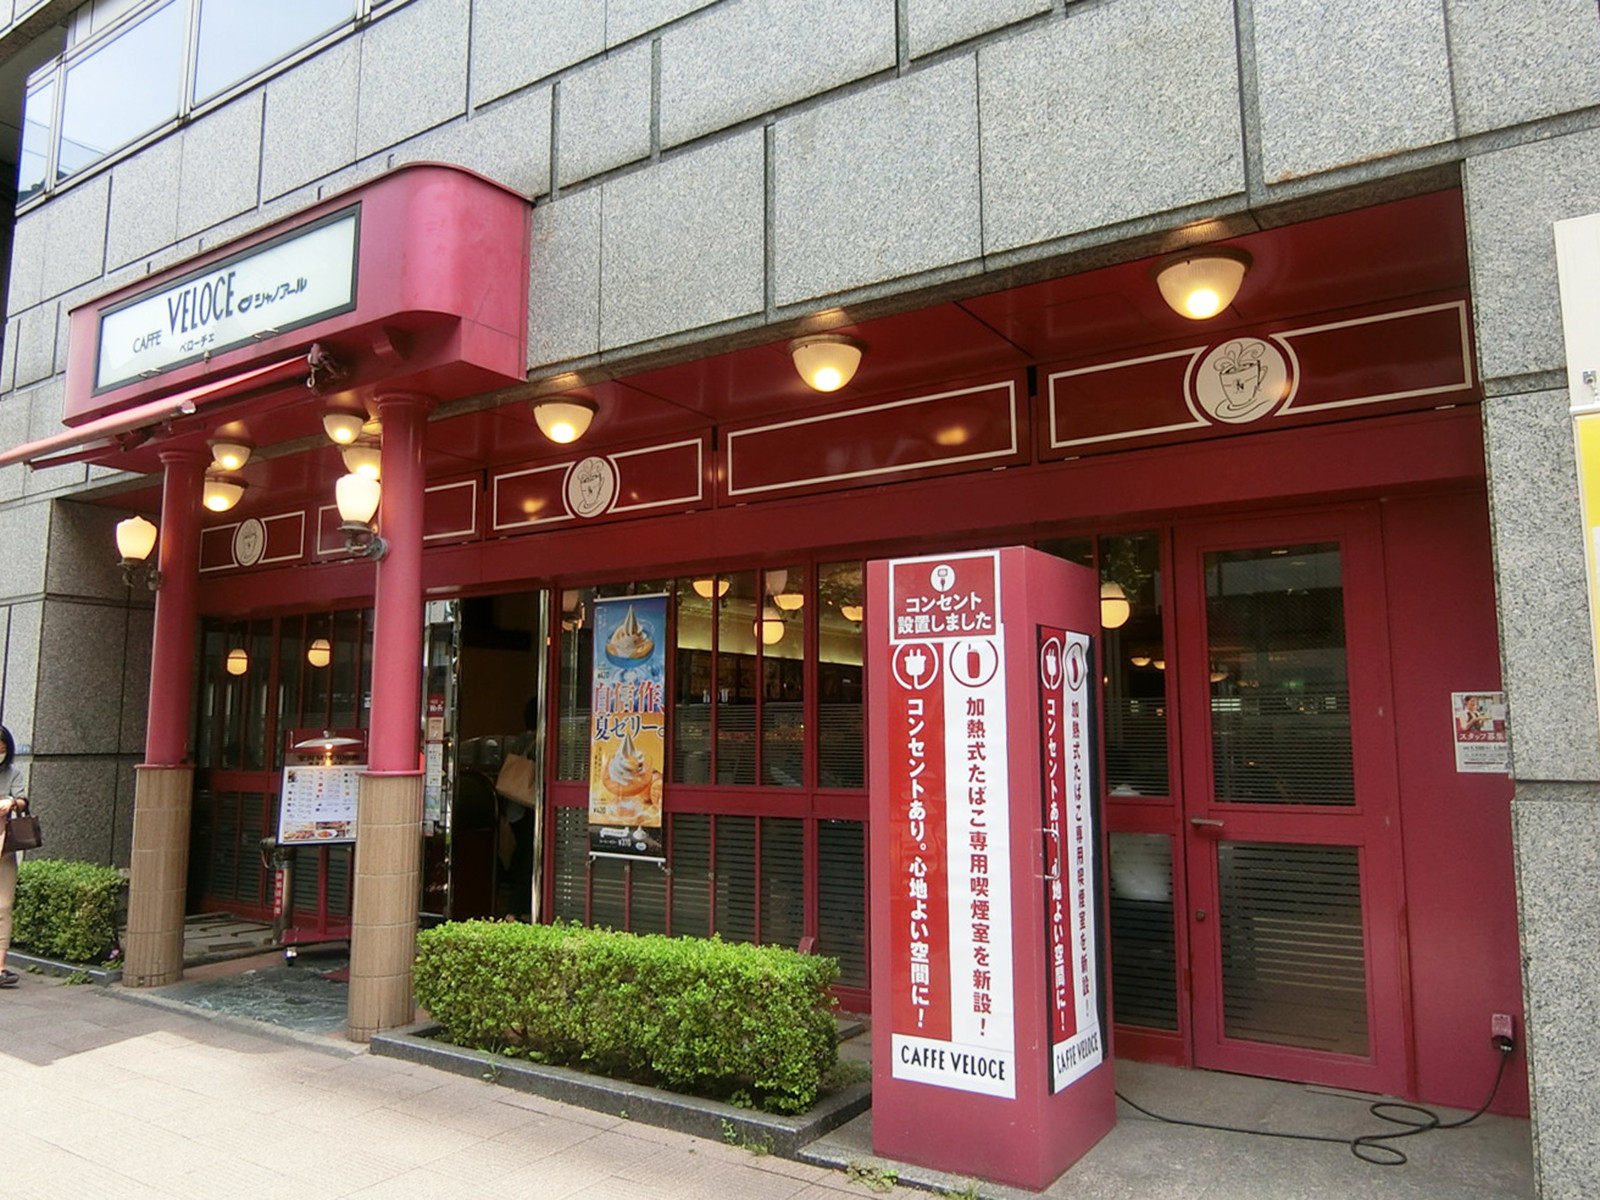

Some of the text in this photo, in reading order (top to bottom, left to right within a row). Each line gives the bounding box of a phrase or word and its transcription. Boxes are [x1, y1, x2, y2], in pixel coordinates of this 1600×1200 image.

[254, 277, 308, 309] シャノアール
[132, 271, 236, 353] CAFFE VELOCE
[905, 591, 982, 614] コンセント
[897, 611, 992, 634] 設置しました
[901, 1044, 1006, 1081] CAFFE VELOCE
[1056, 1031, 1099, 1074] CAFFE VELOCE
